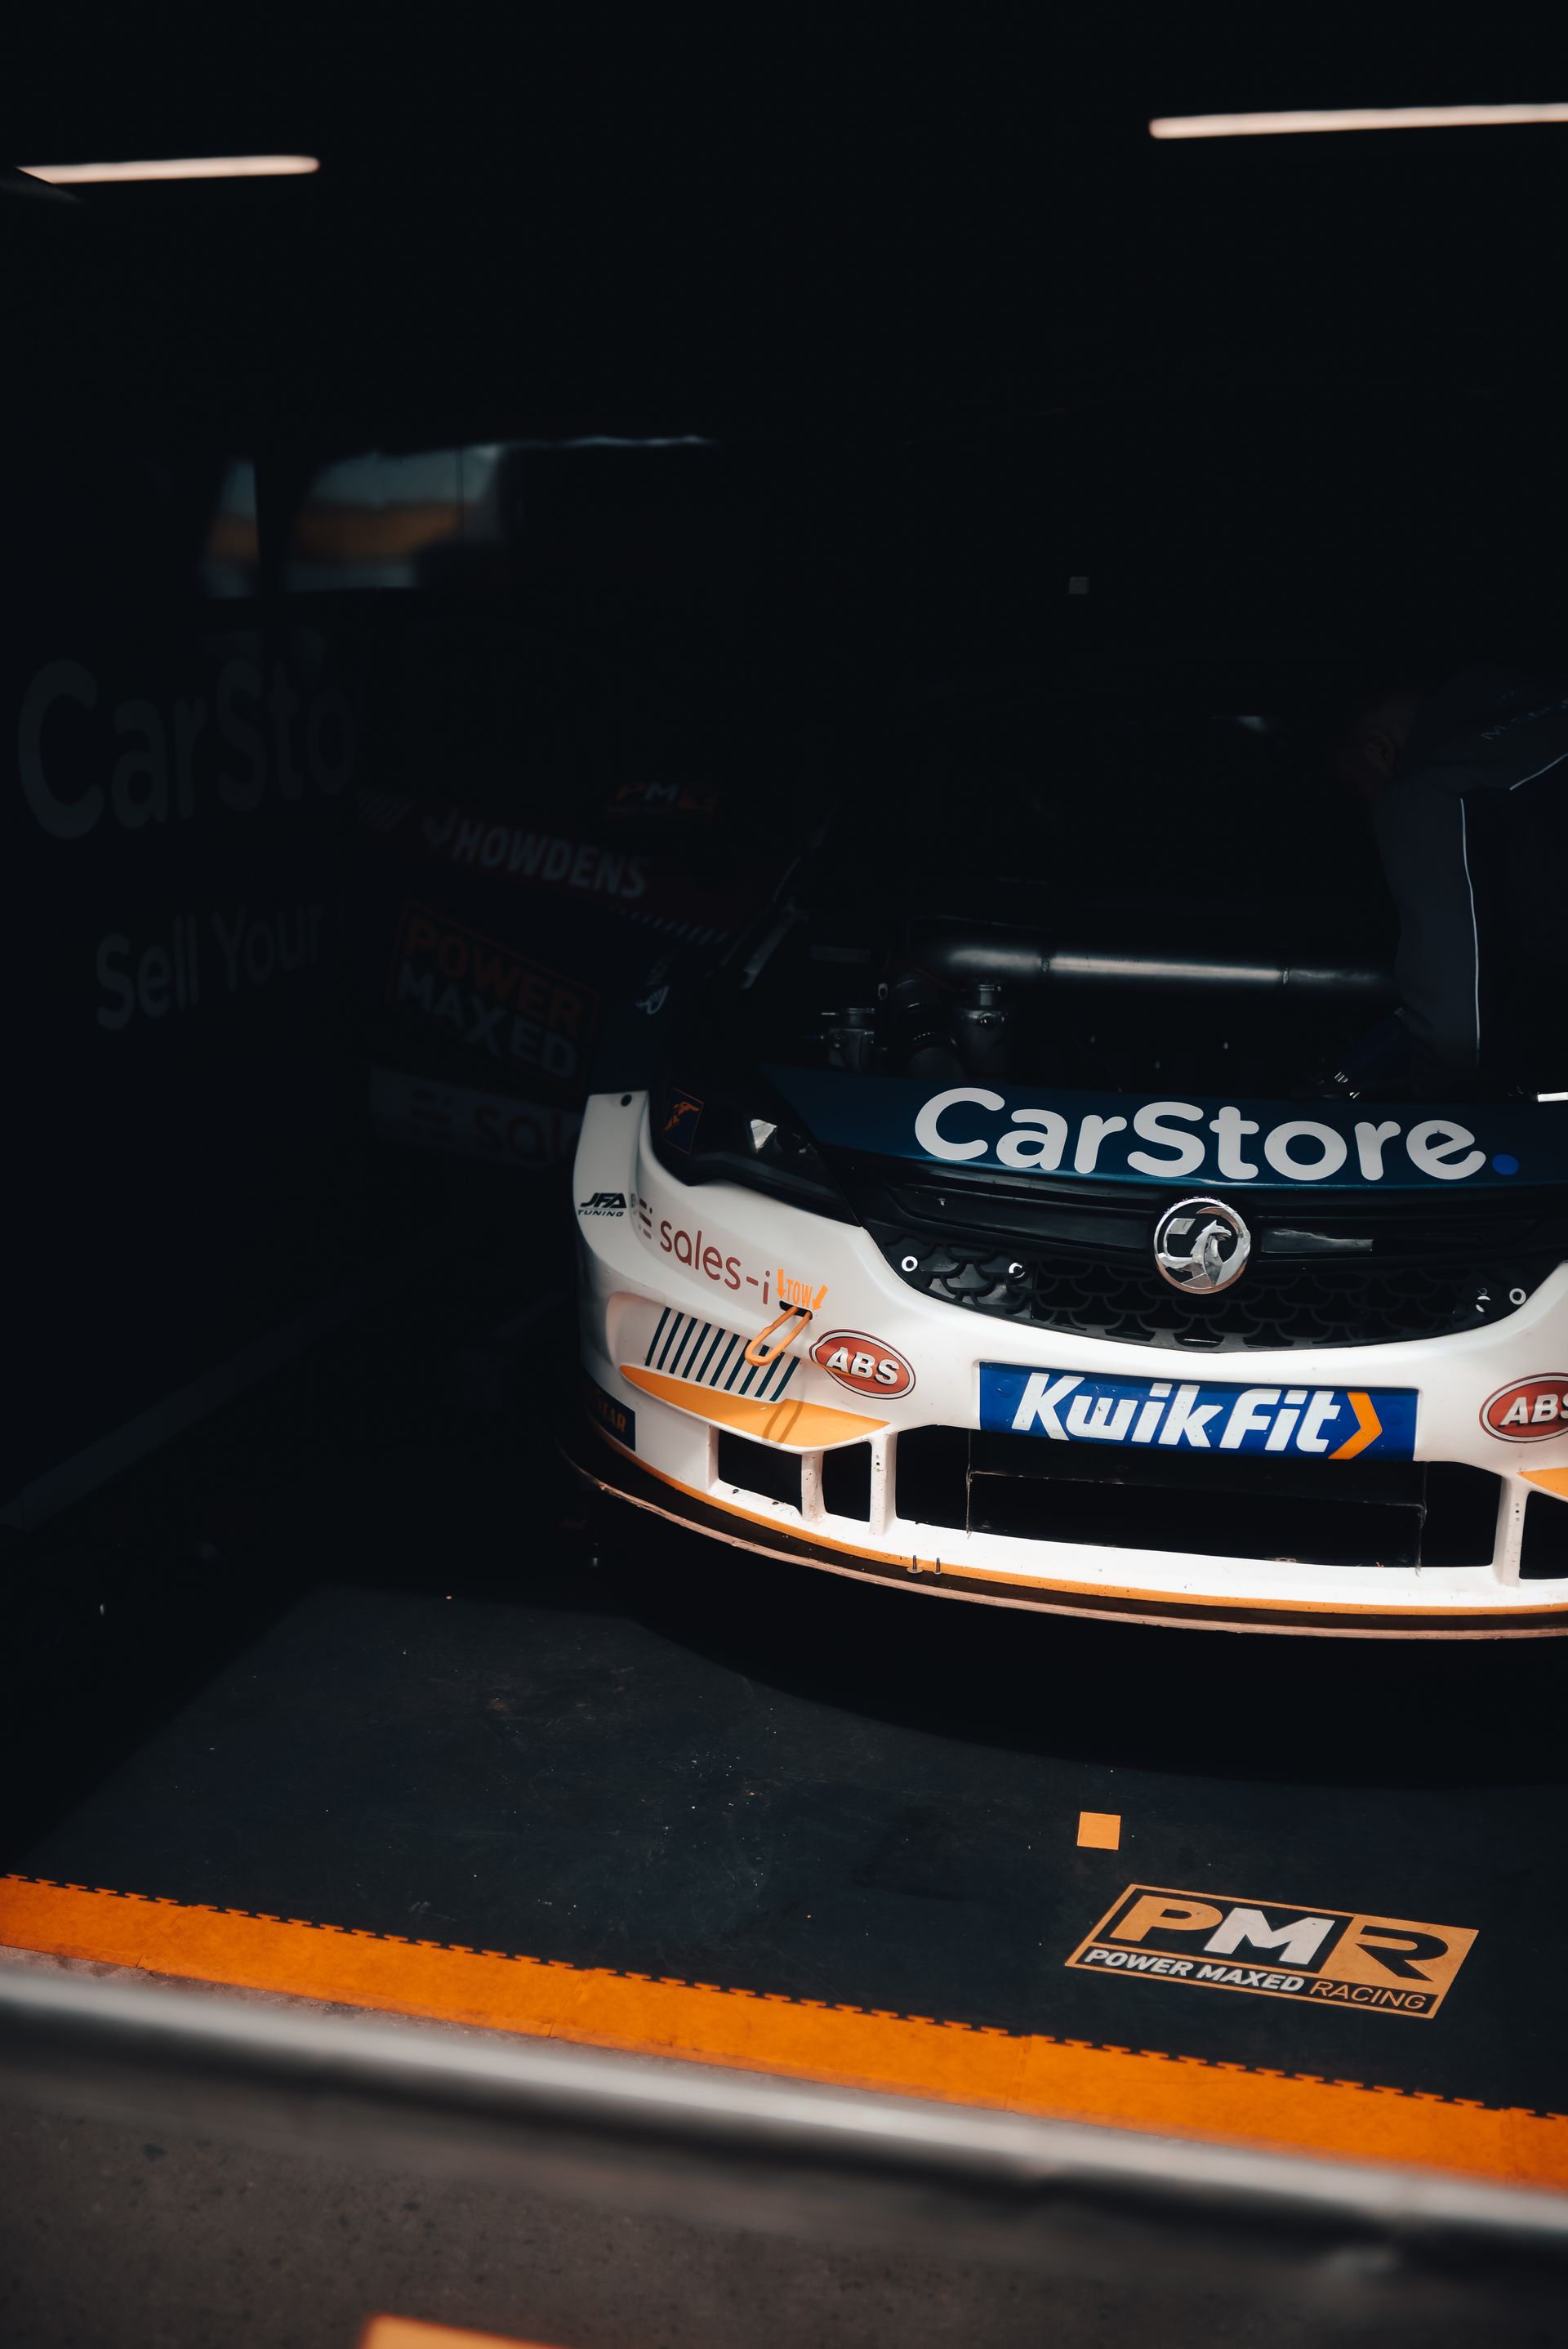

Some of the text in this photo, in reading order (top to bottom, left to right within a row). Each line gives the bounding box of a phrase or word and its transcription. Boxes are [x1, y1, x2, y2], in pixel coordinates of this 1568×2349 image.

[17, 657, 358, 840] CarSto
[451, 818, 652, 899] HOWDENS
[96, 931, 200, 1032] Sell
[211, 903, 325, 994] Your
[408, 914, 582, 1037] POWER
[398, 960, 577, 1079] MAXED
[577, 1209, 624, 1217] TUNING
[581, 1192, 627, 1209] JFA
[660, 1220, 771, 1305] sales-i
[786, 1278, 813, 1308] TOW
[825, 1346, 900, 1386] ABS
[1084, 1948, 1428, 2010] POWER MAXED RACING
[1110, 1894, 1450, 1983] PMR
